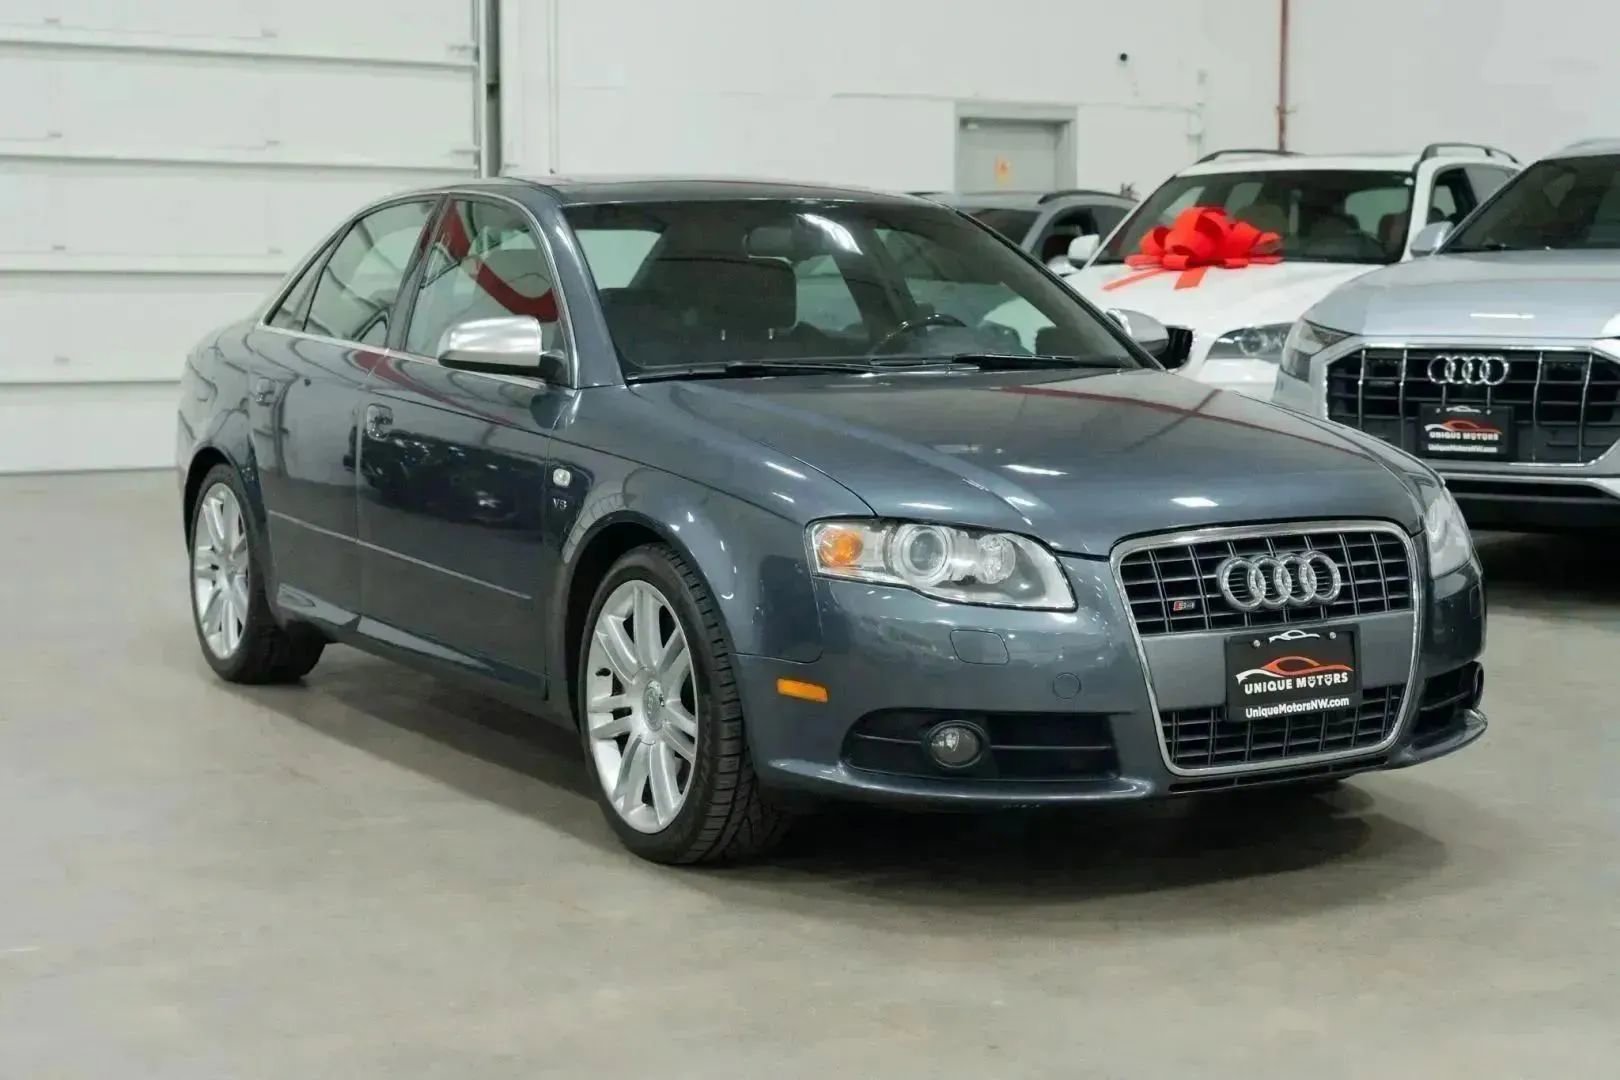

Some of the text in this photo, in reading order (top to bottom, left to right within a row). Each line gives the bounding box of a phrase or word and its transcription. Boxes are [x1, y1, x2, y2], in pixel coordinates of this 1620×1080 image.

[1244, 672, 1349, 695] UNIQUE MOTORS
[1245, 697, 1350, 718] UniqueMotorsNW.com
